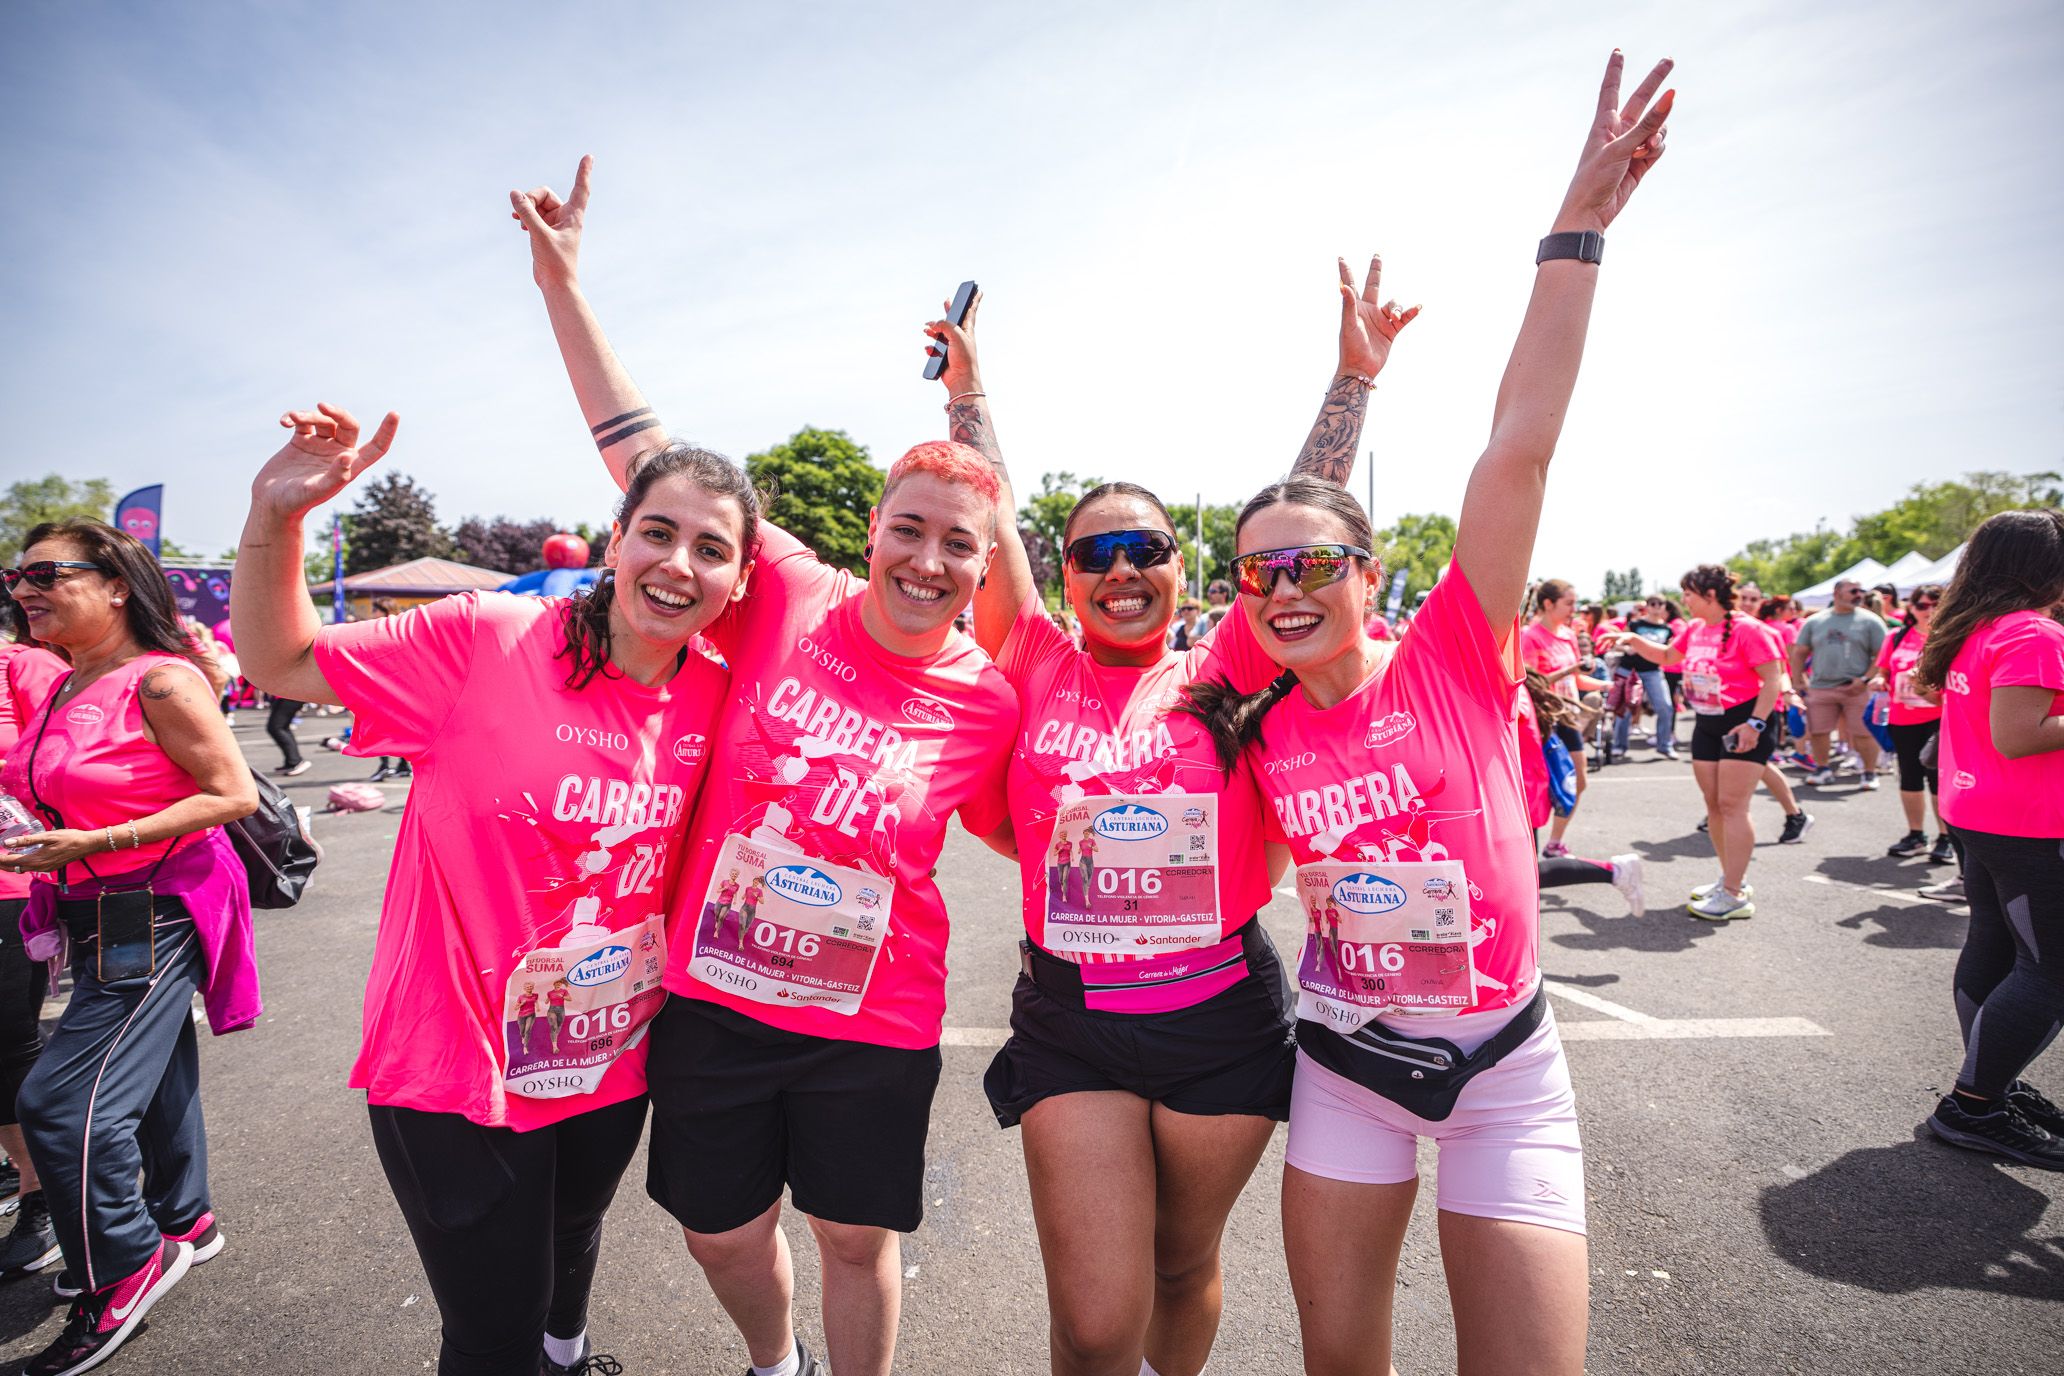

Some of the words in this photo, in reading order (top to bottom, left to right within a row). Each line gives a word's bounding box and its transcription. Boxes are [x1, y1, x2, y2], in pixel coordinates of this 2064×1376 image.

[798, 637, 857, 682] OYSHO
[767, 676, 919, 776] CARRERA
[556, 724, 629, 751] OYSHO
[553, 774, 686, 828] CARRER
[1059, 811, 1090, 824] SUMA
[1098, 817, 1162, 832] ASTURIANA
[736, 851, 765, 869] SUMA
[770, 872, 835, 902] ASTURIANA
[1097, 868, 1163, 895] 016
[1304, 877, 1329, 888] SUMA
[1339, 886, 1400, 904] ASTURIANA
[1123, 899, 1138, 911] 31
[1050, 912, 1083, 922] CARRERA
[1086, 914, 1096, 922] DE
[1098, 915, 1107, 923] LA
[1109, 914, 1137, 923] MUJER
[1144, 912, 1214, 924] VITORIA-GASTEIZ
[754, 922, 821, 957] 016
[1063, 931, 1115, 945] OYSHO
[1150, 935, 1202, 945] Santander
[771, 955, 794, 968] 694
[1341, 943, 1405, 972] 016
[526, 963, 564, 974] SUMA
[699, 946, 734, 961] CARRERA
[735, 955, 746, 966] DE
[746, 960, 756, 969] LA
[758, 964, 785, 978] MUJER
[791, 973, 860, 992] VITORIA-GASTEIZ
[706, 964, 758, 991] OYSHO
[1301, 980, 1336, 996] CARRERA
[1339, 989, 1346, 999] DE
[1361, 977, 1385, 991] 300
[790, 991, 842, 1004] Santander
[569, 1003, 631, 1039] 016
[1315, 1001, 1360, 1026] OYSHO
[591, 1036, 612, 1051] 696
[510, 1061, 550, 1076] CARRERA
[552, 1059, 564, 1067] DE
[566, 1058, 578, 1066] LA
[579, 1052, 608, 1066] MUJER
[523, 1075, 583, 1094] OYSHO
